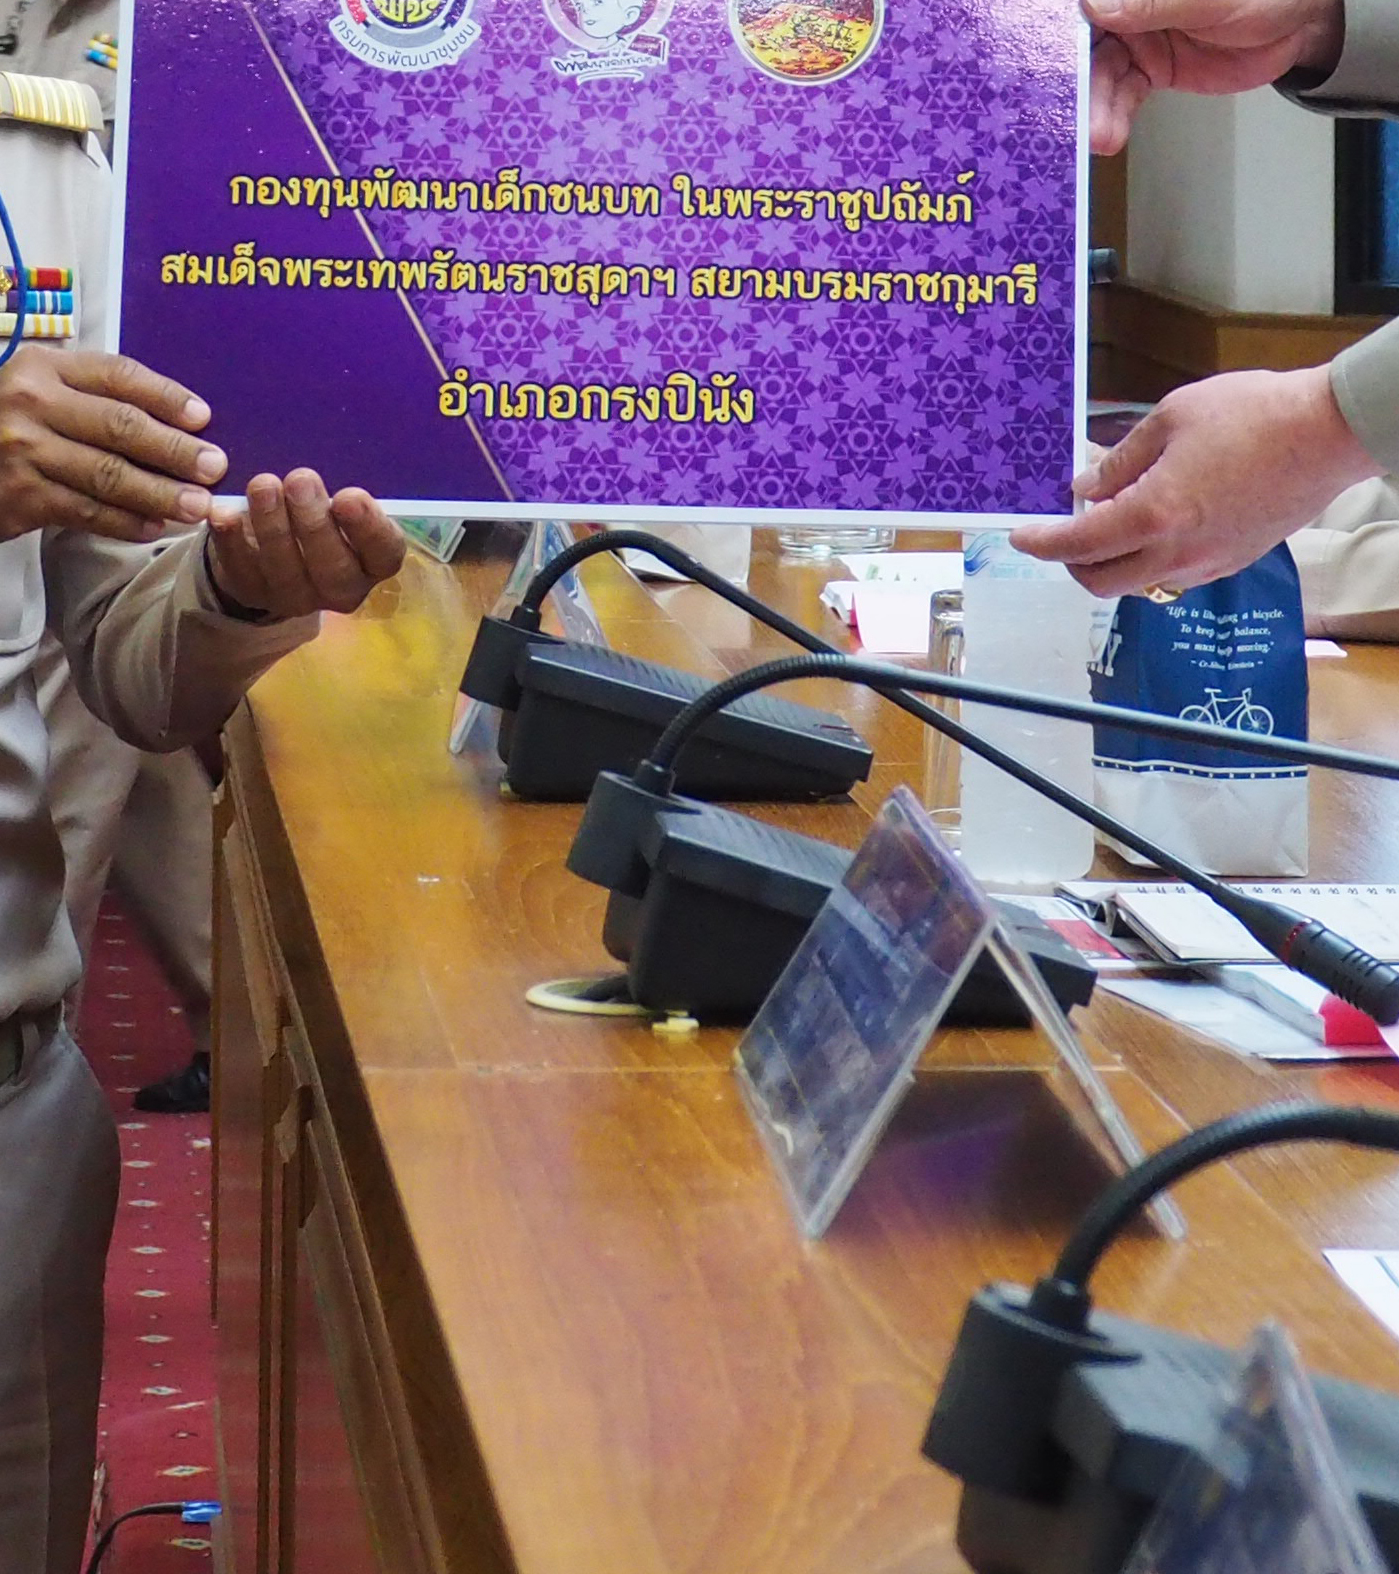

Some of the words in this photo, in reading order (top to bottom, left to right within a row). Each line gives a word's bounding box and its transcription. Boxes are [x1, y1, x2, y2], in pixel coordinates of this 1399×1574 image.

[334, 20, 476, 67] กรมการพัฒนาชุมชน
[230, 168, 659, 218] กองทุนพัฒนาเด็กชนบท
[674, 170, 973, 230] ในพระราชูปถัมภ์
[161, 243, 676, 304] สมเด็จพระเทพรัตนราชสุดาฯ
[691, 262, 1038, 312] สยามบรมราชกุมารี
[438, 368, 754, 424] อำเภอกรงปินัง
[1180, 624, 1192, 634] To
[1191, 608, 1199, 618] is
